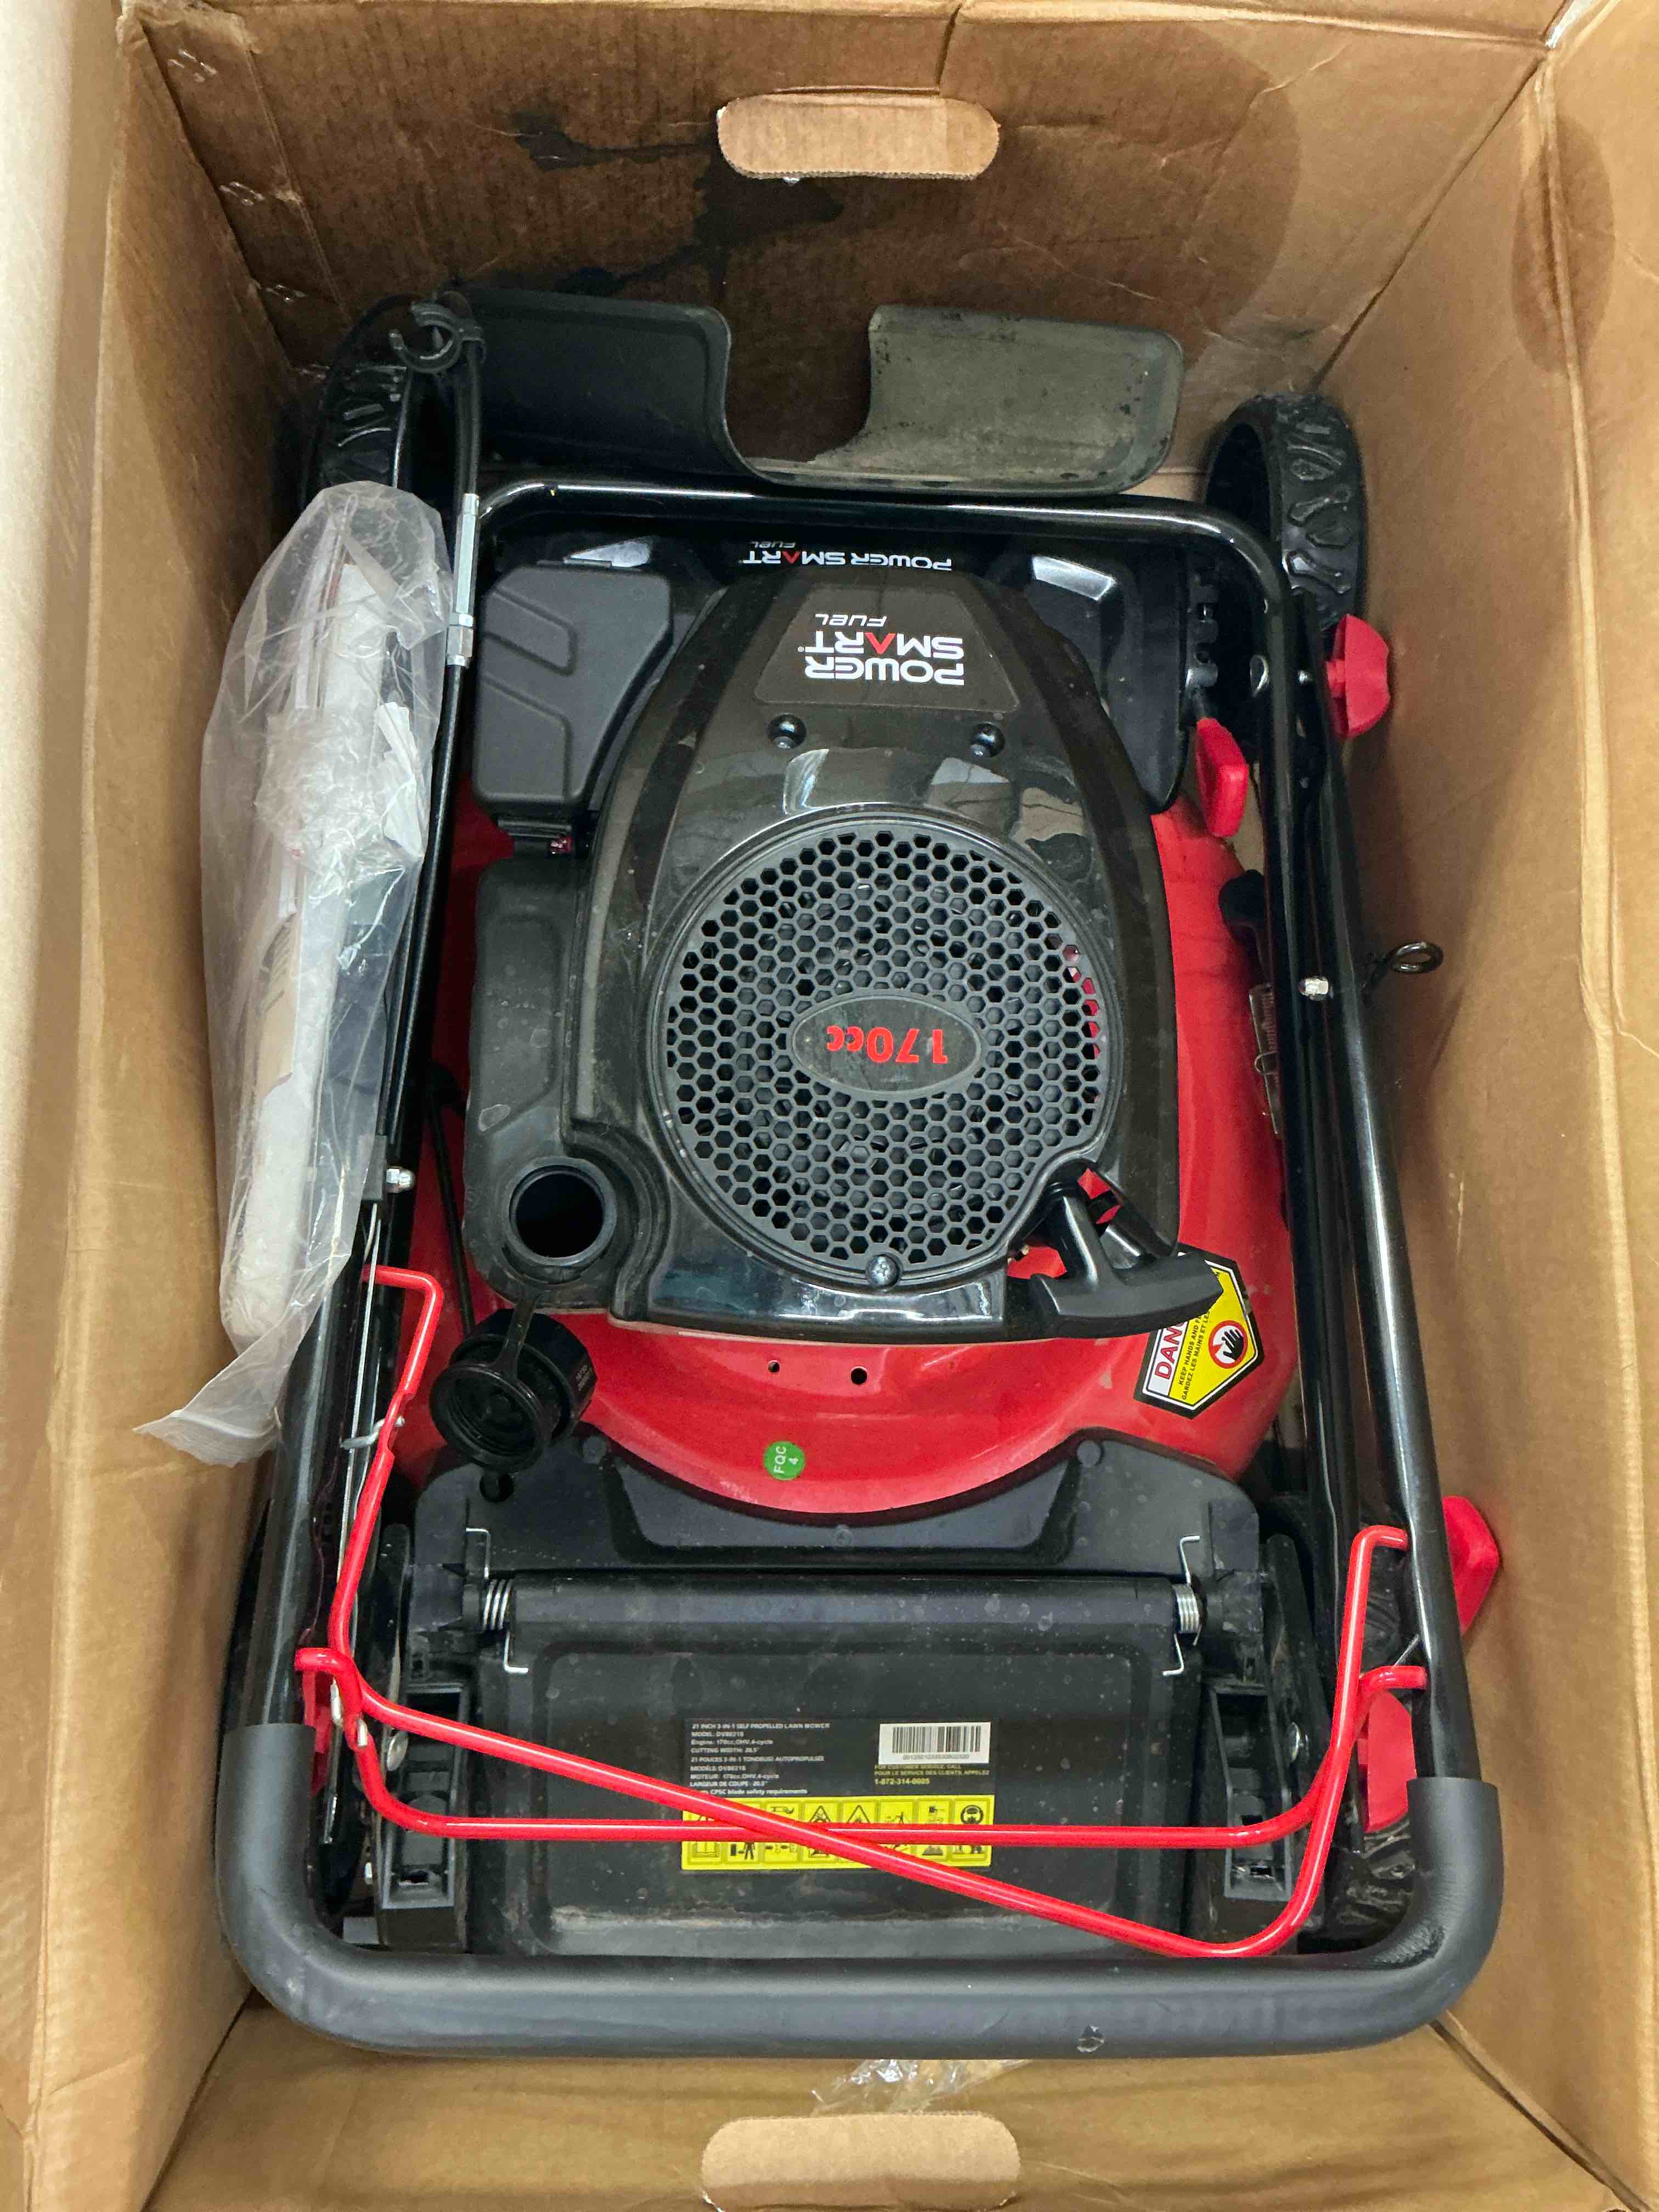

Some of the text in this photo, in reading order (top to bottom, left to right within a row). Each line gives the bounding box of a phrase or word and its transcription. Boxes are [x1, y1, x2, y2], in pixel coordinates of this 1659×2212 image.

[742, 550, 952, 571] POWER SMART
[804, 630, 964, 659] SMART
[804, 656, 964, 686] POWER
[826, 1025, 948, 1064] 170cc
[1154, 1322, 1185, 1379] DAN
[1178, 1367, 1187, 1385] KEEP
[1185, 1341, 1195, 1366] HANDS
[1182, 1374, 1193, 1400] GARDEZ
[1194, 1333, 1204, 1356] MAINS
[1201, 1323, 1206, 1333] ET
[773, 1446, 787, 1474] FQC
[788, 1457, 799, 1465] 4
